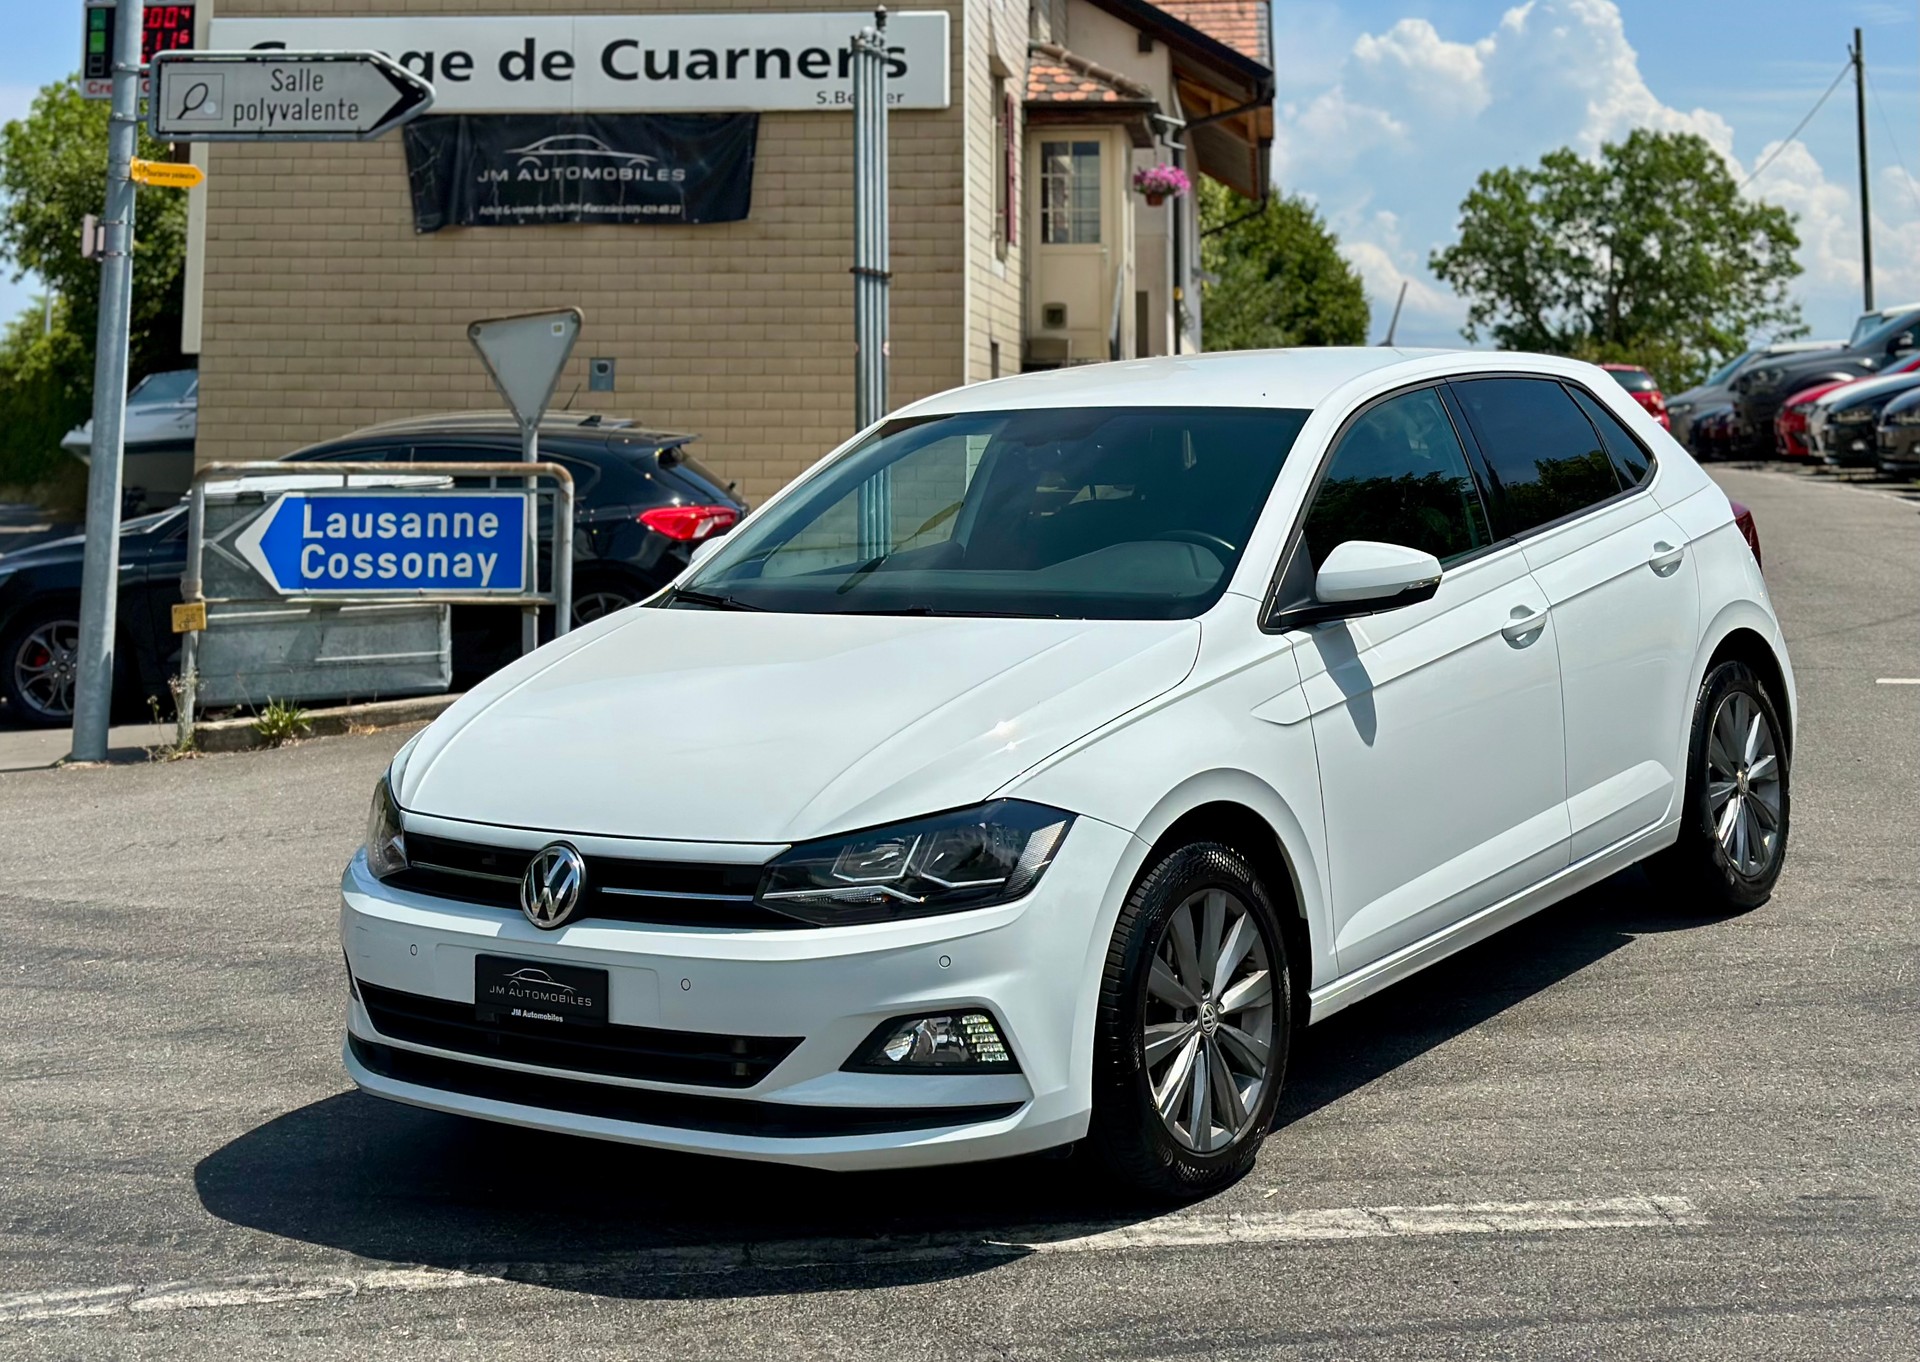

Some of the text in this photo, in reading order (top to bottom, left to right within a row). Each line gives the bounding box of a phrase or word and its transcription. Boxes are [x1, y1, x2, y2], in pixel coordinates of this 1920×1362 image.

[498, 37, 575, 82] de
[271, 68, 324, 92] Salle
[233, 97, 360, 128] polyvalente
[477, 166, 686, 183] JM AUTOMOBILES
[302, 503, 500, 540] Lausanne
[300, 543, 499, 587] Cossonay
[489, 985, 592, 1007] JM AUTOMOBILES
[511, 1008, 564, 1022] JM Automobiles
